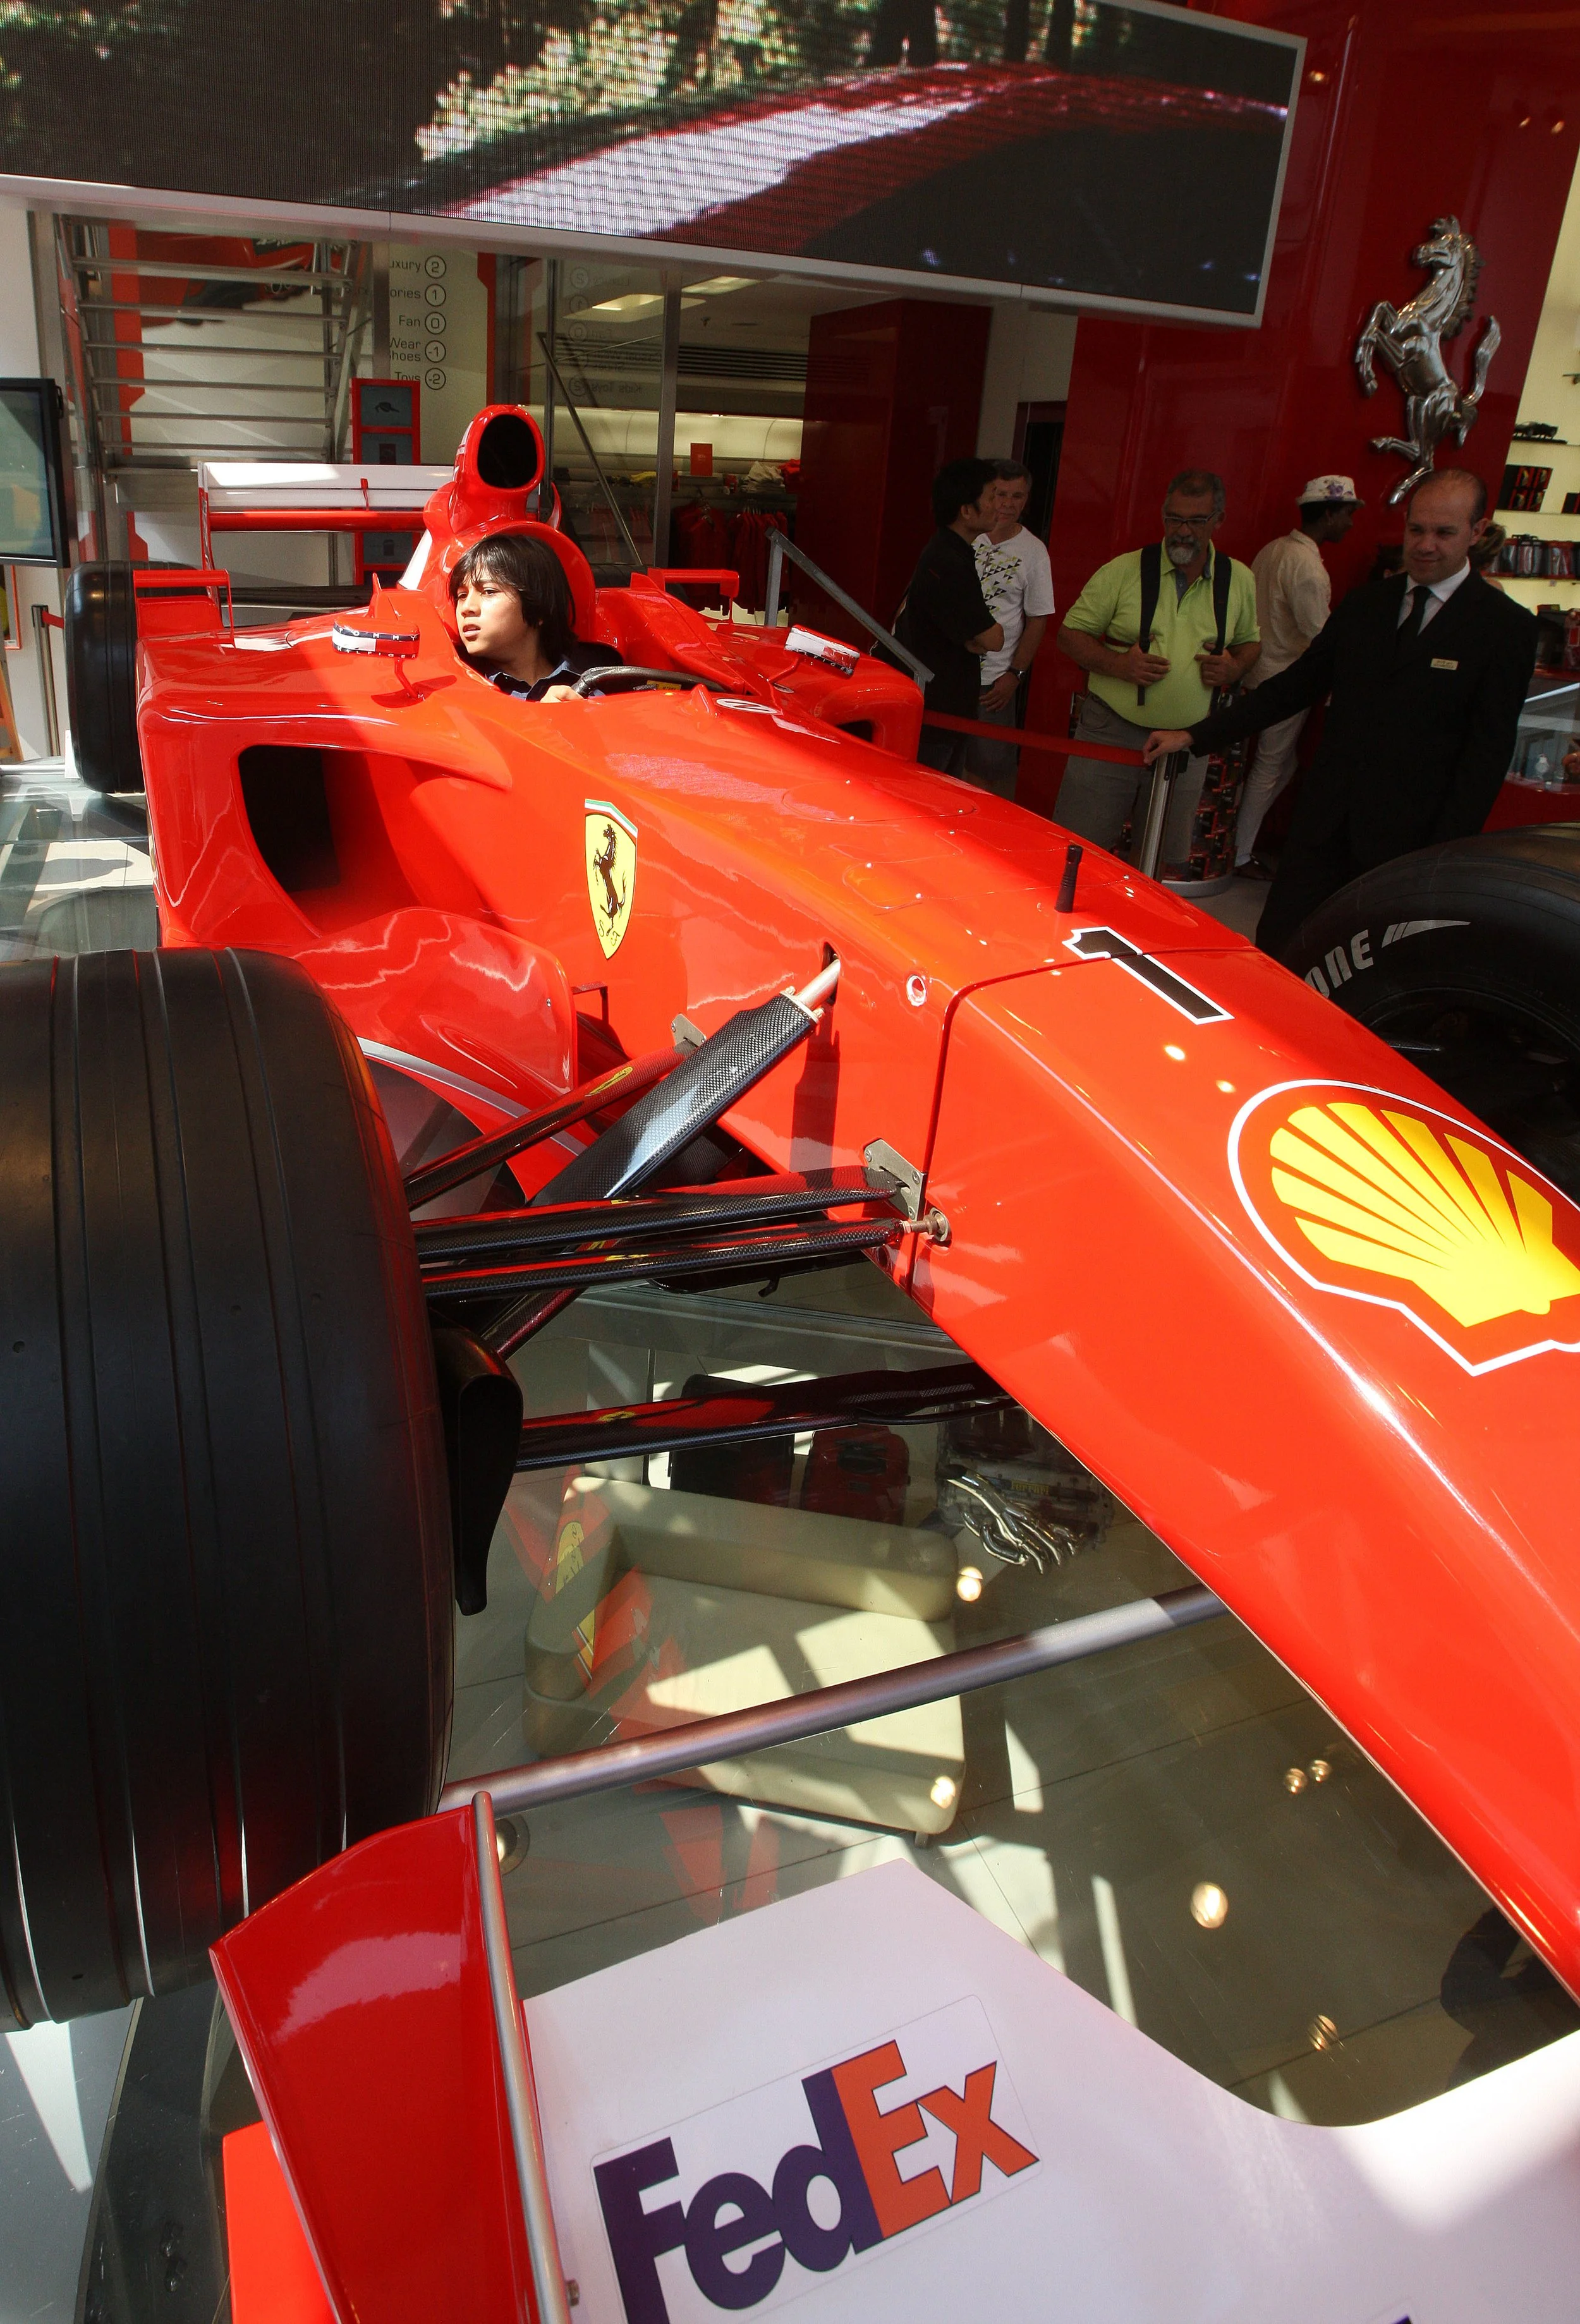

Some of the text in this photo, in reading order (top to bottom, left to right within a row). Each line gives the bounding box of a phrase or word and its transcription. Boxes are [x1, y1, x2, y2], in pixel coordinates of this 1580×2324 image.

[390, 287, 420, 298] ories
[399, 315, 420, 327] Fan
[389, 350, 421, 361] hoes
[428, 346, 439, 357] -1
[428, 373, 441, 385] -2
[339, 627, 420, 641] TOMMY
[1062, 926, 1235, 1025] 1
[593, 2039, 1040, 2324] FedEx
